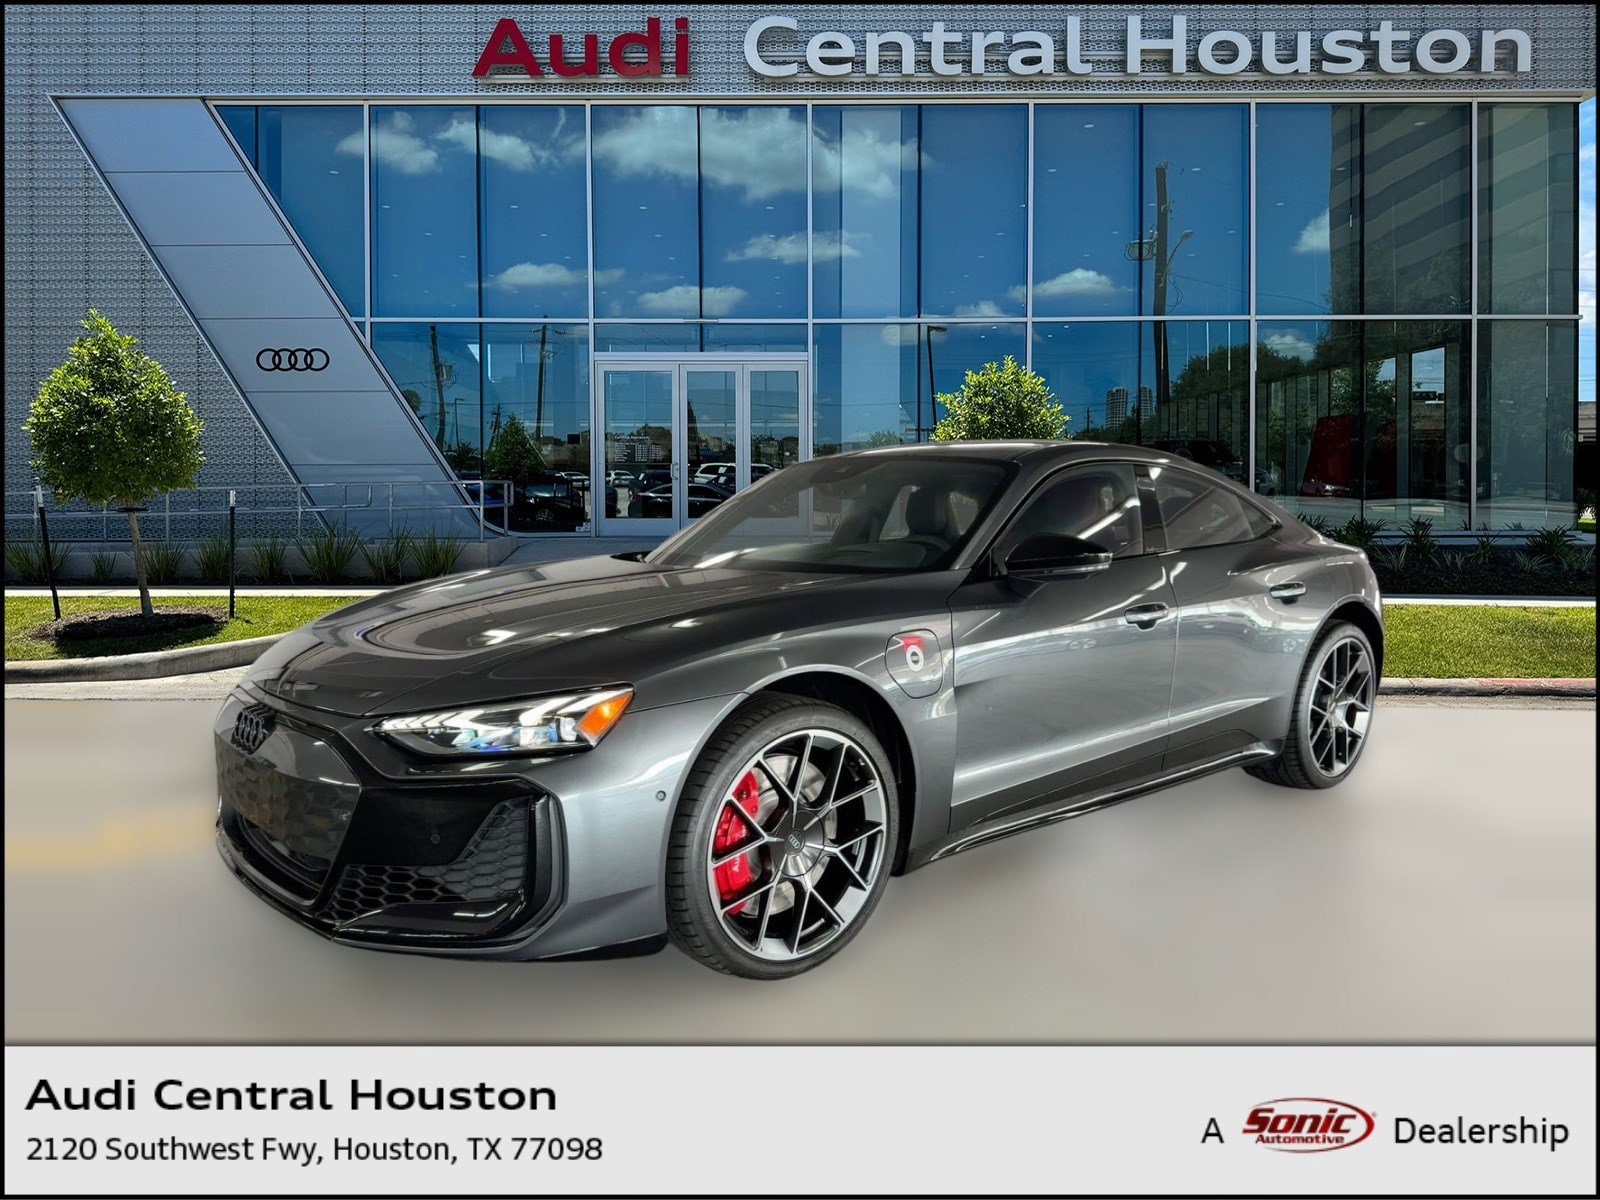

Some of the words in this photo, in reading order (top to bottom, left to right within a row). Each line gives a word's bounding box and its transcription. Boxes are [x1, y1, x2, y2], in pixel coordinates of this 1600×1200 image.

[472, 17, 689, 77] Audi
[744, 15, 1093, 77] Central
[1126, 15, 1532, 75] Houston
